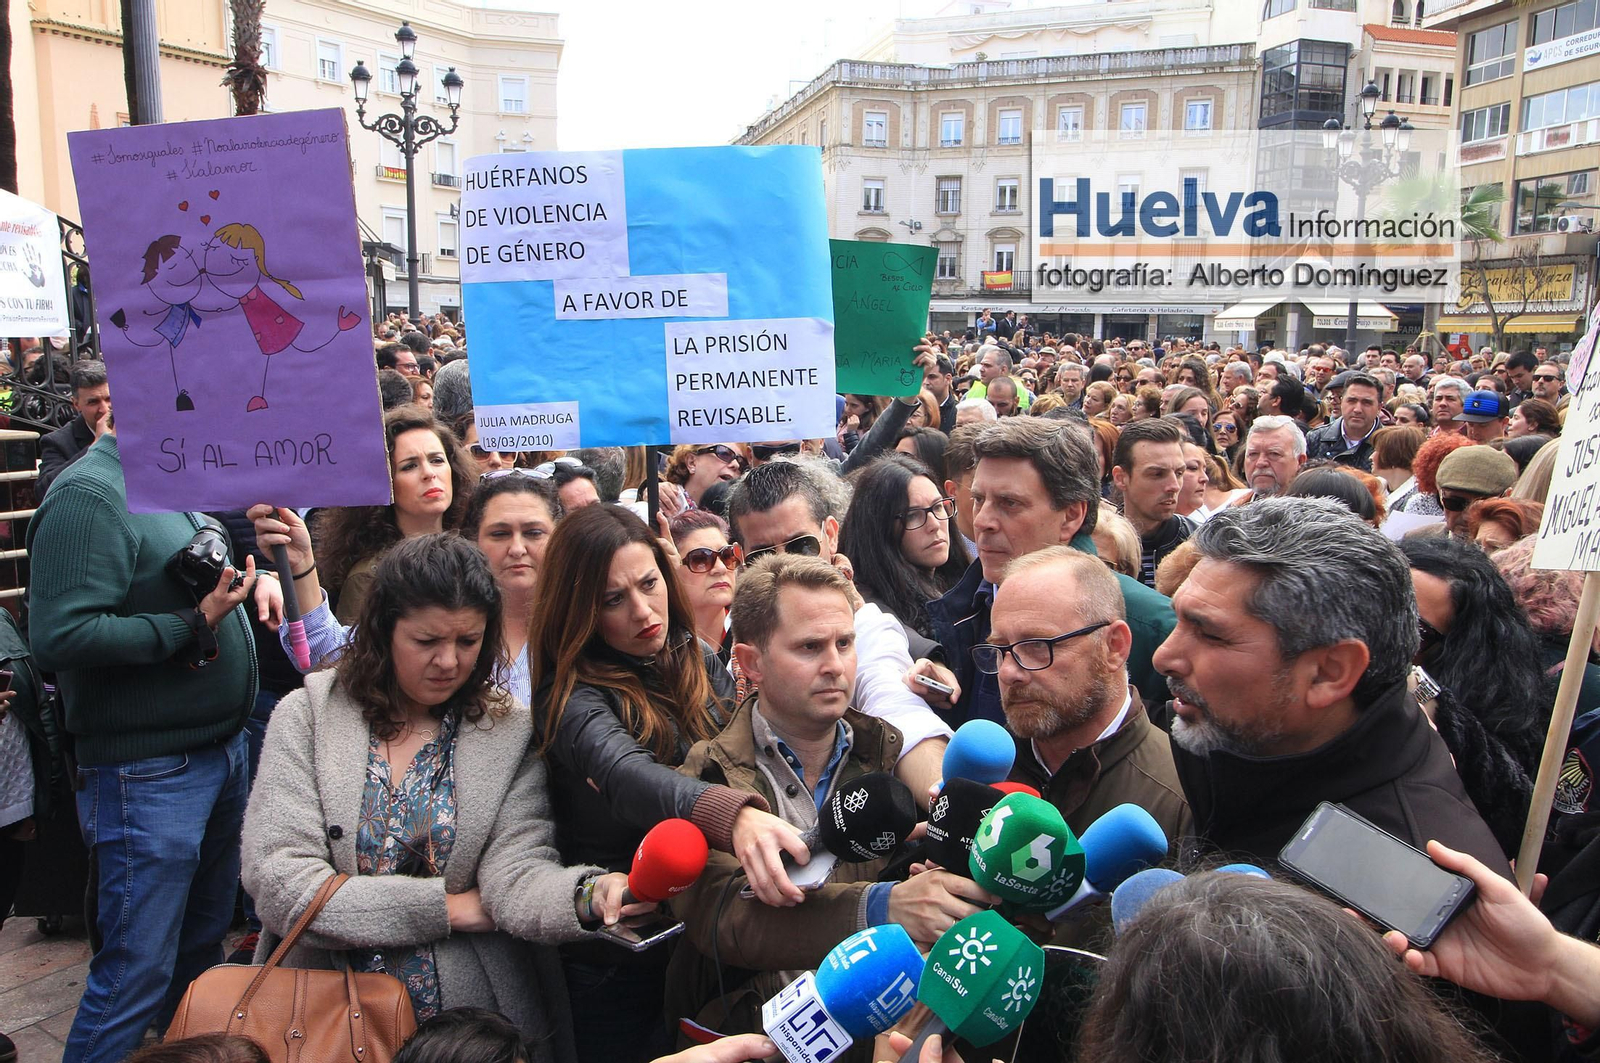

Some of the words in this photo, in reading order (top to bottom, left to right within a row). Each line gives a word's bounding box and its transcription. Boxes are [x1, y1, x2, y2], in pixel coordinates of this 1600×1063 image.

[465, 165, 588, 191] HUÉRFANOS
[465, 209, 488, 228] DE
[493, 202, 608, 226] VIOLENCIA
[466, 246, 491, 265] DE
[497, 239, 585, 263] GÉNERO
[562, 294, 577, 313] A
[583, 291, 653, 312] FAVOR
[661, 289, 689, 308] DE
[673, 337, 699, 355] LA
[705, 329, 788, 353] PRISIÓN
[675, 368, 819, 391] PERMANENTE
[479, 416, 506, 428] JULIA
[509, 412, 573, 427] MADRUGA
[677, 405, 792, 427] REVISABLE.
[203, 444, 238, 470] AL
[254, 433, 337, 466] AMOR
[482, 433, 554, 448] (18/03/2010)
[1541, 482, 1597, 539] MIGUEL
[994, 871, 1039, 895] laSexta
[933, 962, 969, 998] CanalSur
